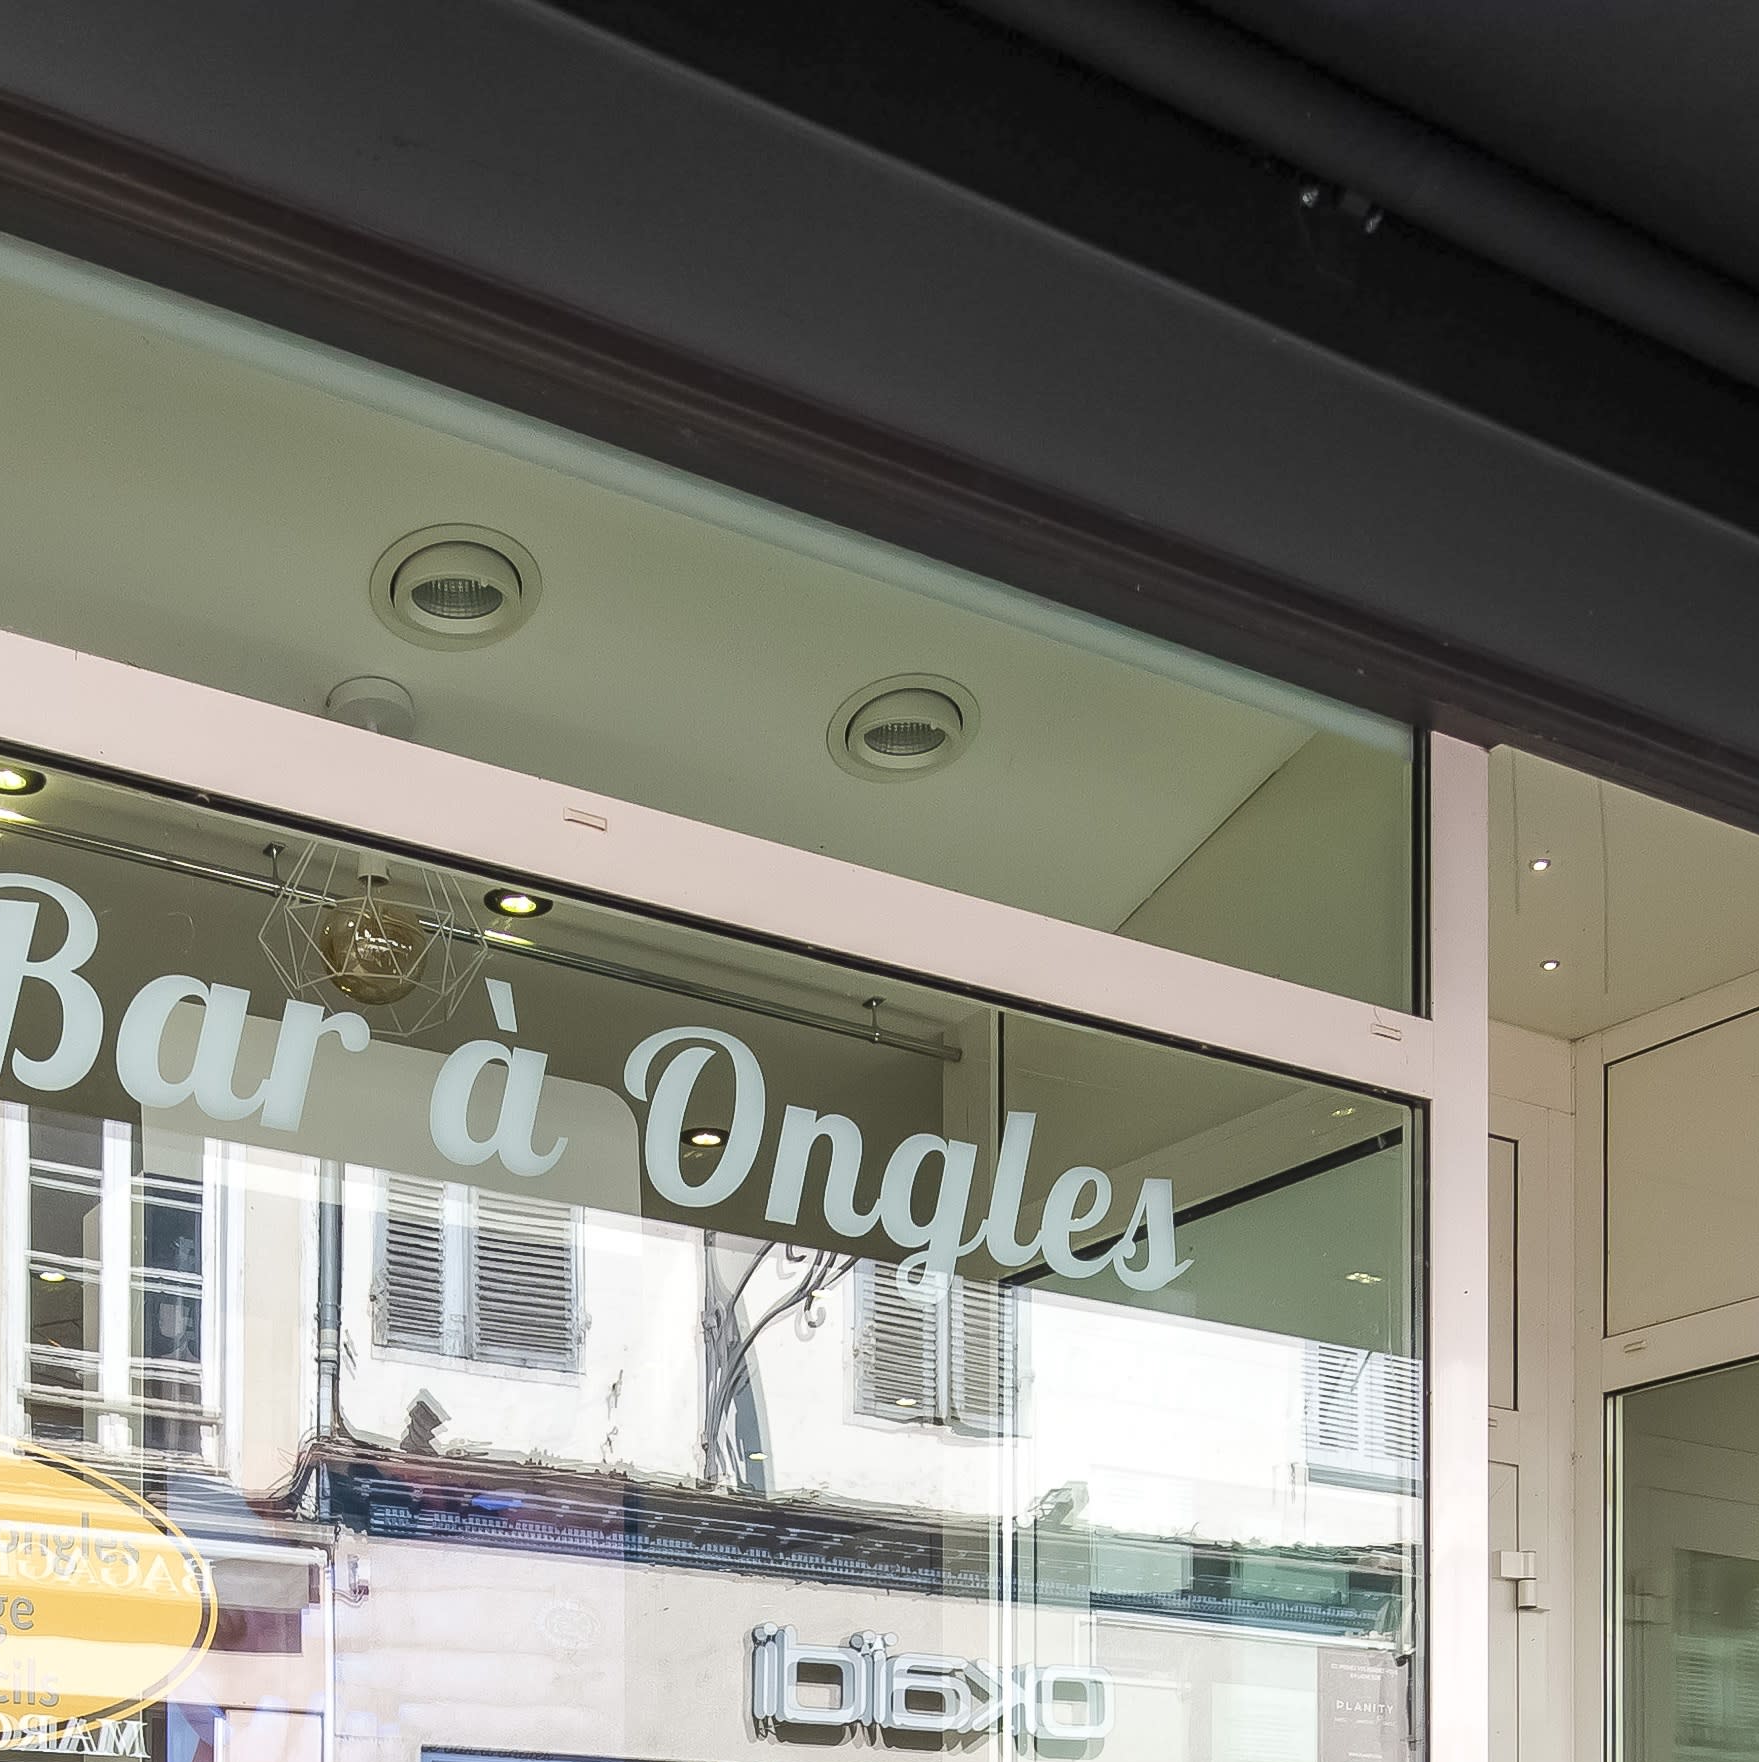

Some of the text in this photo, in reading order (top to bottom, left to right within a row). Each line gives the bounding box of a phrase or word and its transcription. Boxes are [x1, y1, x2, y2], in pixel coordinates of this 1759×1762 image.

[428, 978, 568, 1177] à
[624, 1025, 1193, 1303] Ongles
[1335, 1699, 1394, 1715] PLANITY
